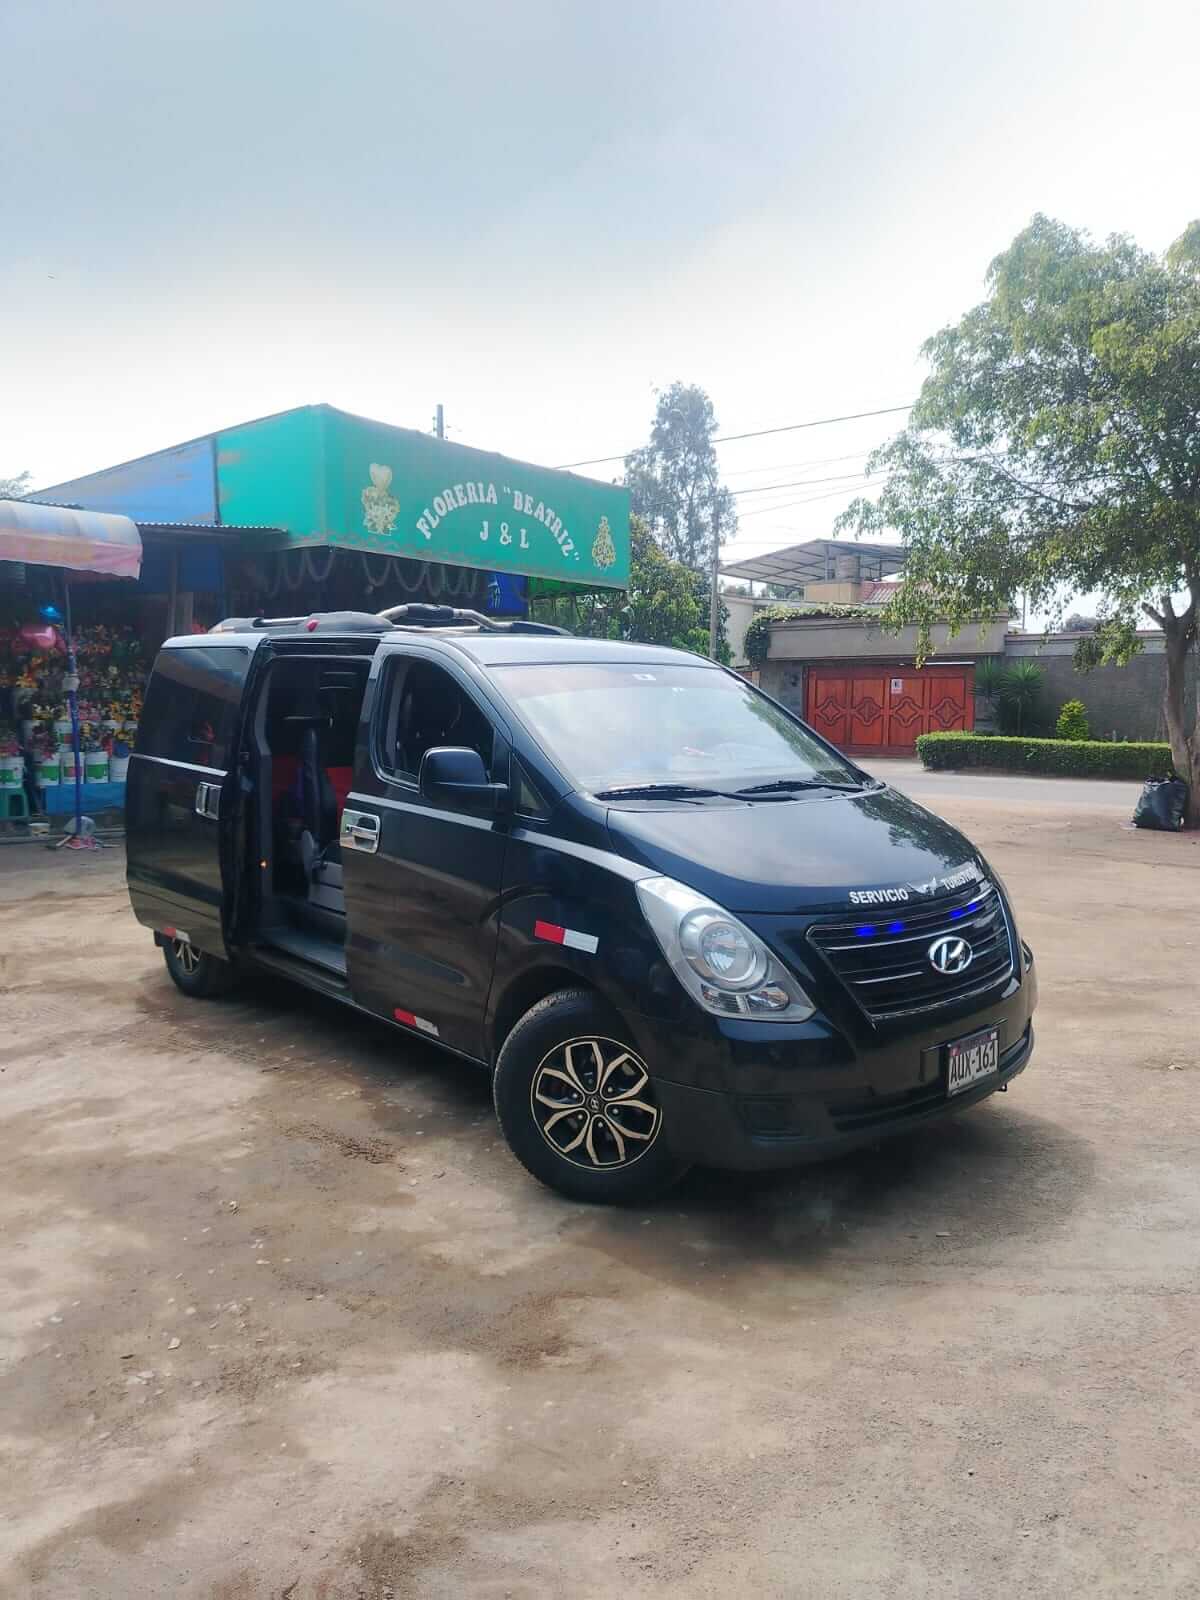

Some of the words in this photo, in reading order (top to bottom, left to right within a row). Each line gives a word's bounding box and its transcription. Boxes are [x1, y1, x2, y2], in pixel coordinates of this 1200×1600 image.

[416, 481, 498, 540] FLORERIA
[480, 520, 489, 541] J
[500, 522, 512, 545] &
[520, 528, 530, 549] L
[850, 887, 909, 904] SERVICIO
[950, 1041, 996, 1085] AUX-161
